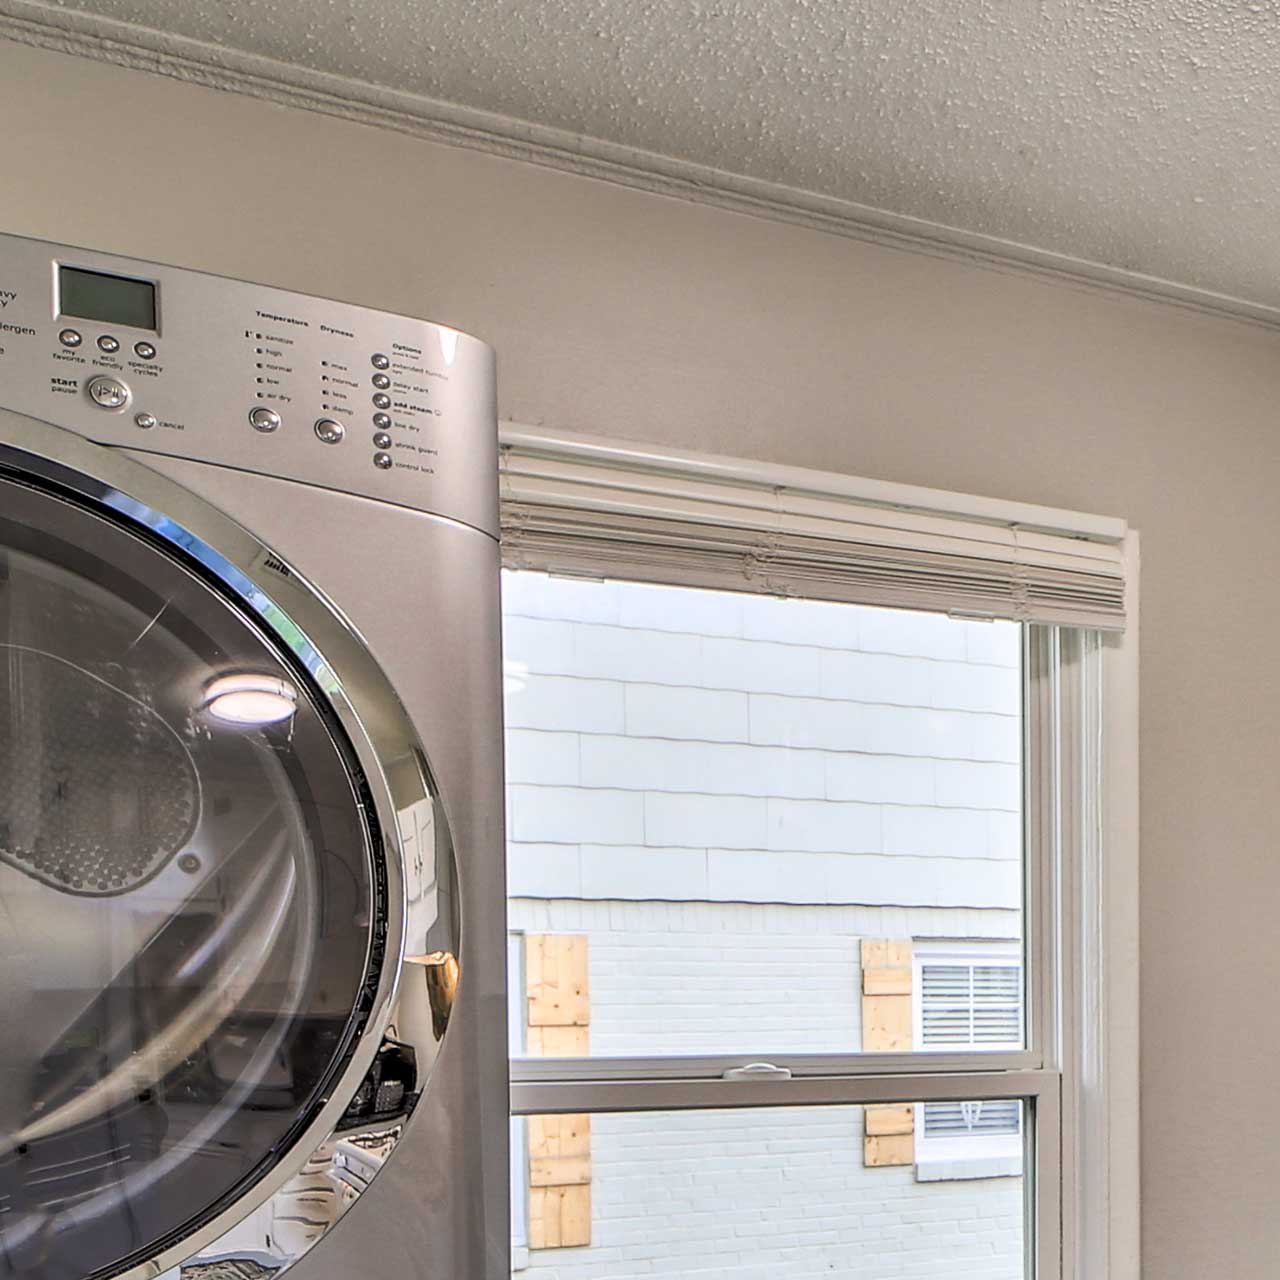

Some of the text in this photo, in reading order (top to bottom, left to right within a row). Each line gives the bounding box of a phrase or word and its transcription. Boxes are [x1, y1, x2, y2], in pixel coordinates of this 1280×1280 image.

[256, 311, 309, 326] Temperature
[320, 325, 354, 338] Dryness
[265, 335, 294, 344] sanitize
[265, 349, 282, 357] high
[392, 343, 422, 354] Options
[53, 352, 85, 364] favorite
[92, 360, 124, 371] friendly
[128, 361, 164, 373] specialty
[266, 364, 292, 373] normal
[133, 369, 159, 377] cycles
[51, 378, 78, 388] start
[332, 377, 359, 388] normal
[51, 386, 78, 394] pause
[409, 405, 433, 414] steam
[159, 421, 185, 430] cancel
